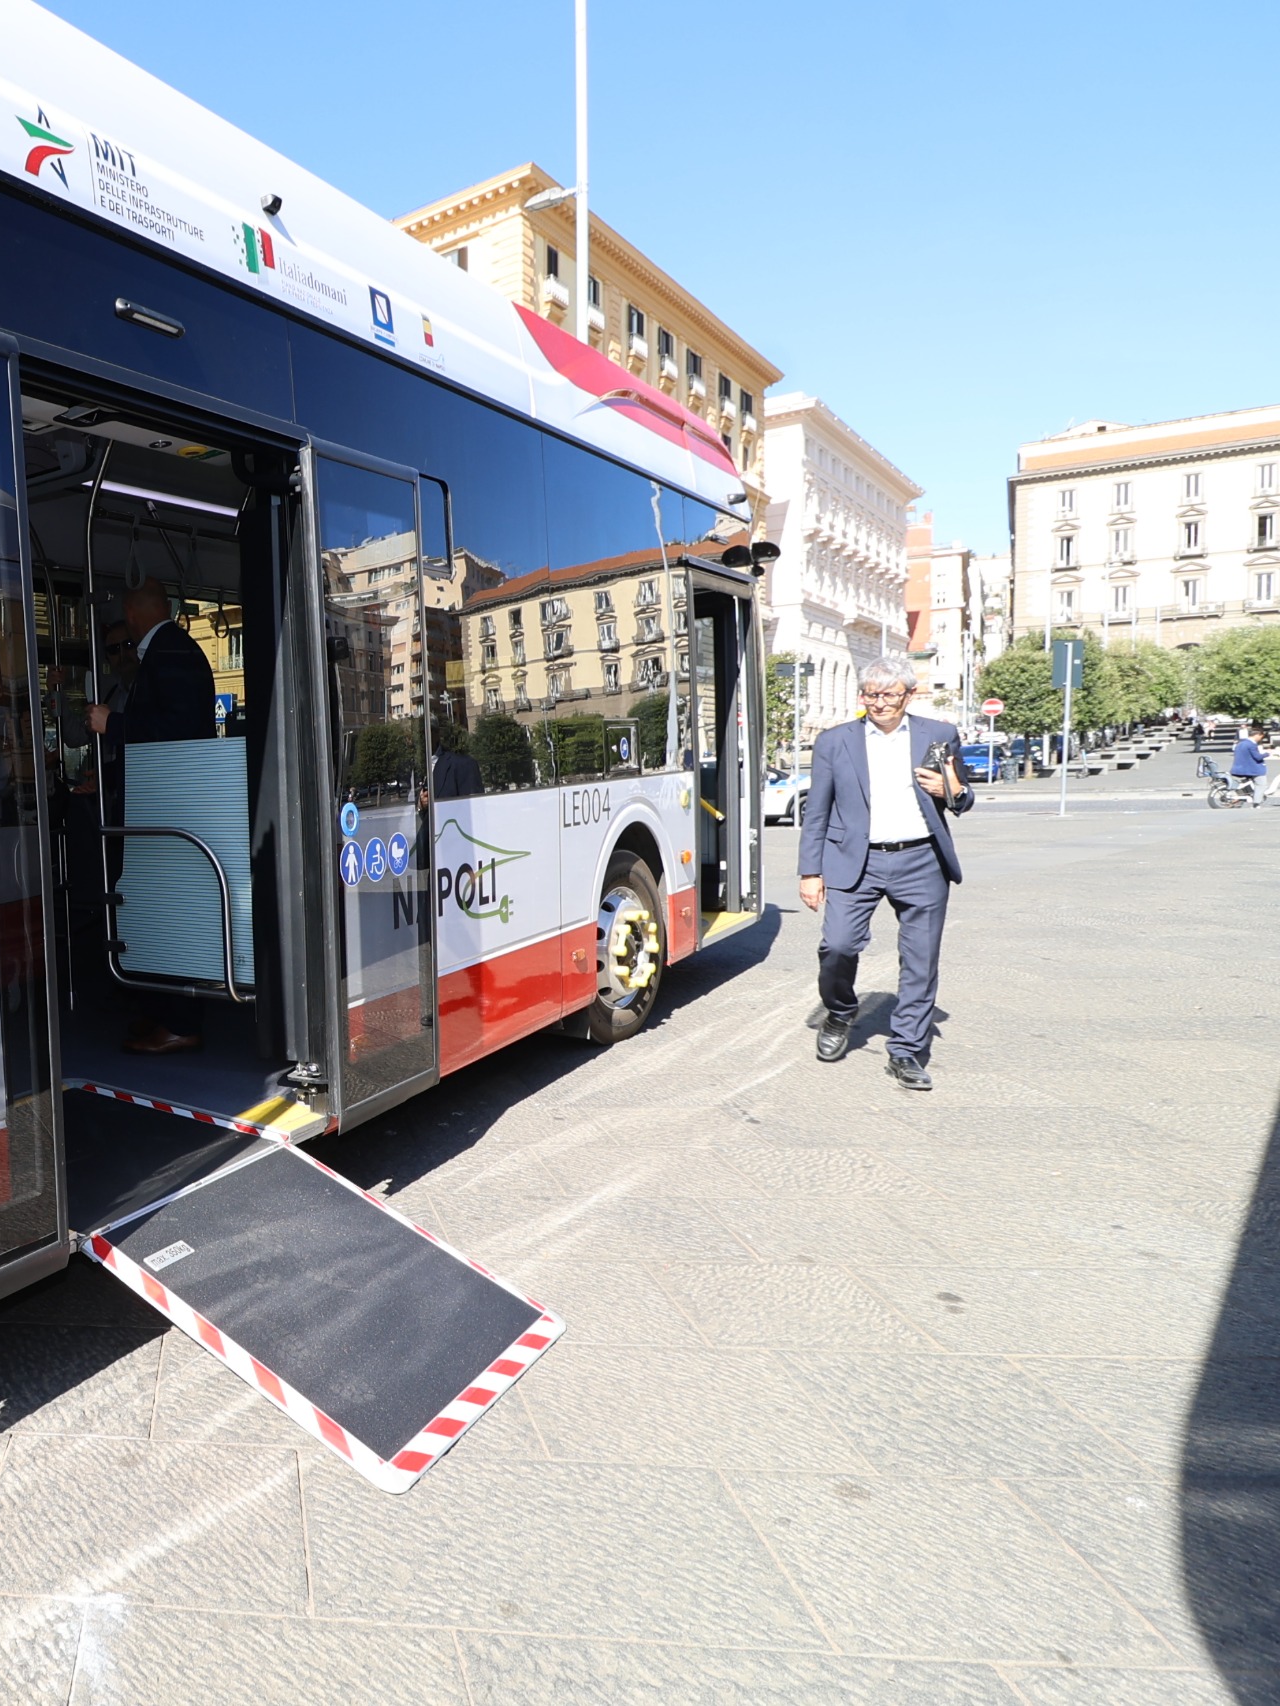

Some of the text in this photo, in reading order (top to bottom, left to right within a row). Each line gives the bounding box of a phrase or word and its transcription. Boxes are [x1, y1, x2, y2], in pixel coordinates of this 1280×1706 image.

[90, 132, 136, 178] MIT
[96, 161, 149, 199] MINISTERO
[98, 178, 205, 241] DELLE INFRASTRUTTURE
[100, 195, 175, 241] E DEI TRASPORTI
[278, 257, 348, 306] Italiadomani
[562, 787, 612, 828] LE004
[392, 857, 497, 930] NPOLI
